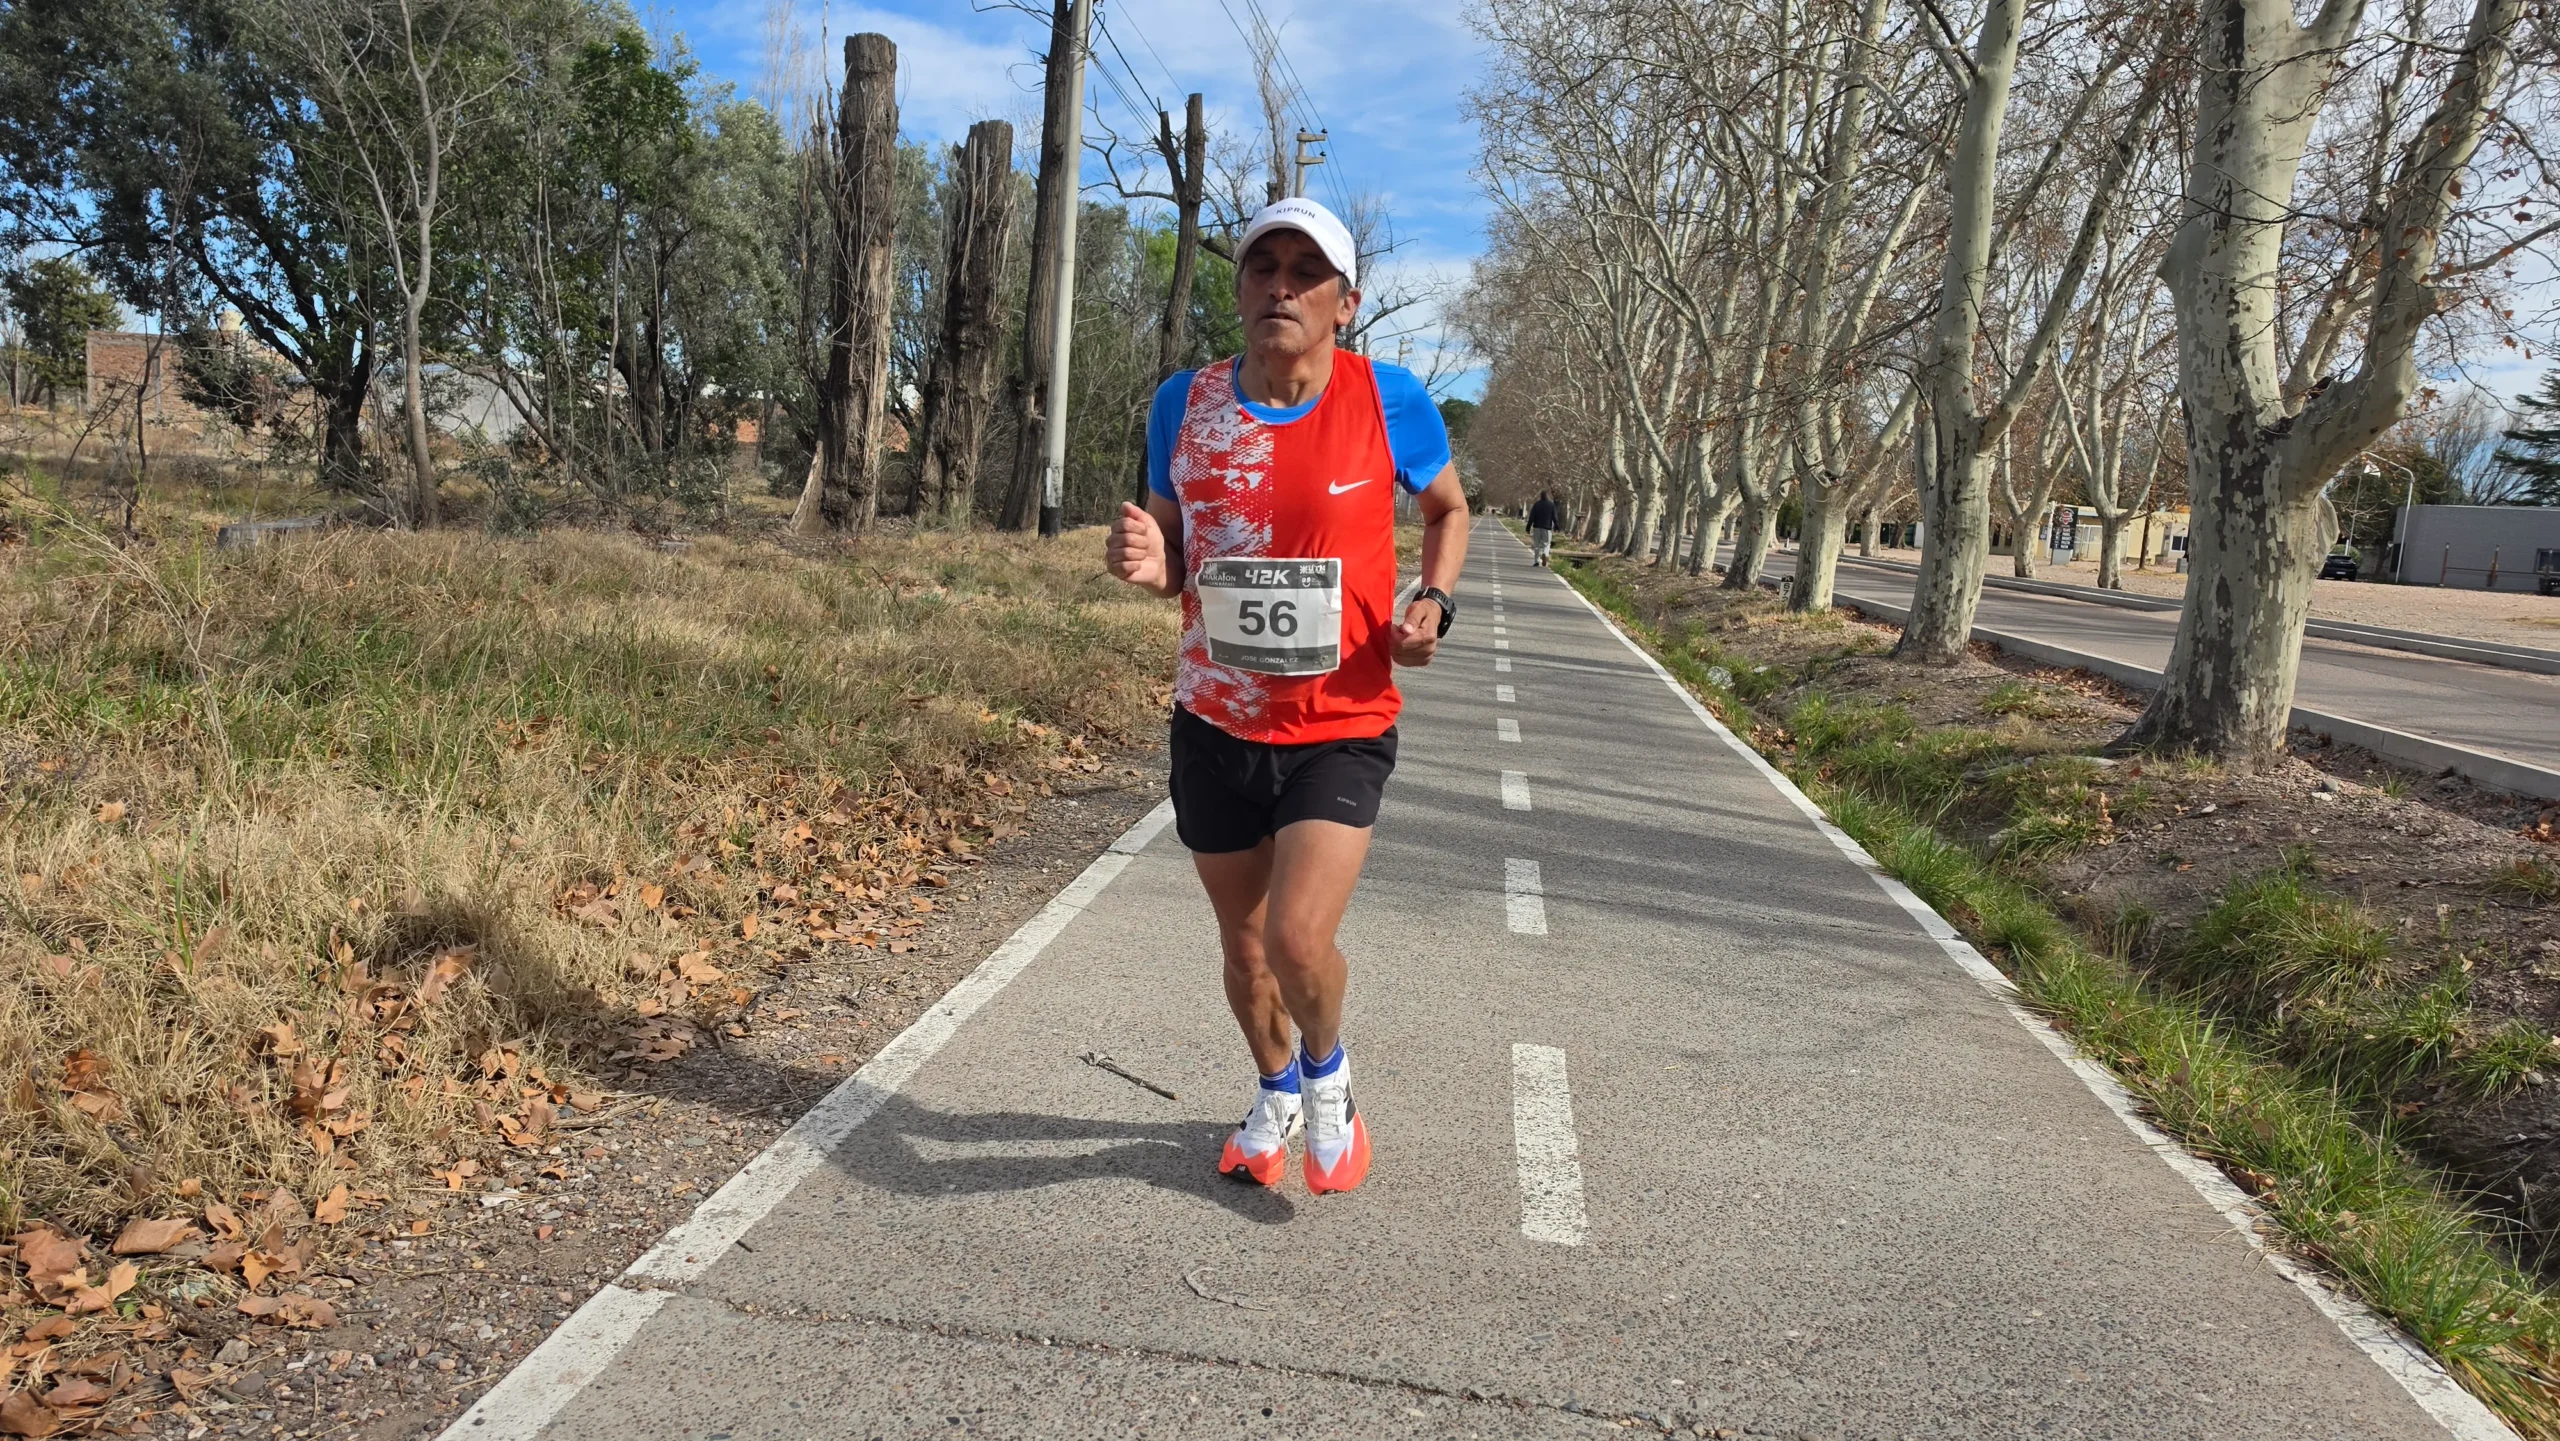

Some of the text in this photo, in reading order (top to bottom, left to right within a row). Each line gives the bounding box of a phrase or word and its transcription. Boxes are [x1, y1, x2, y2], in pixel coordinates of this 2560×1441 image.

[1276, 207, 1315, 219] KIPRUN
[1245, 570, 1290, 585] 42K
[1238, 600, 1298, 637] 56
